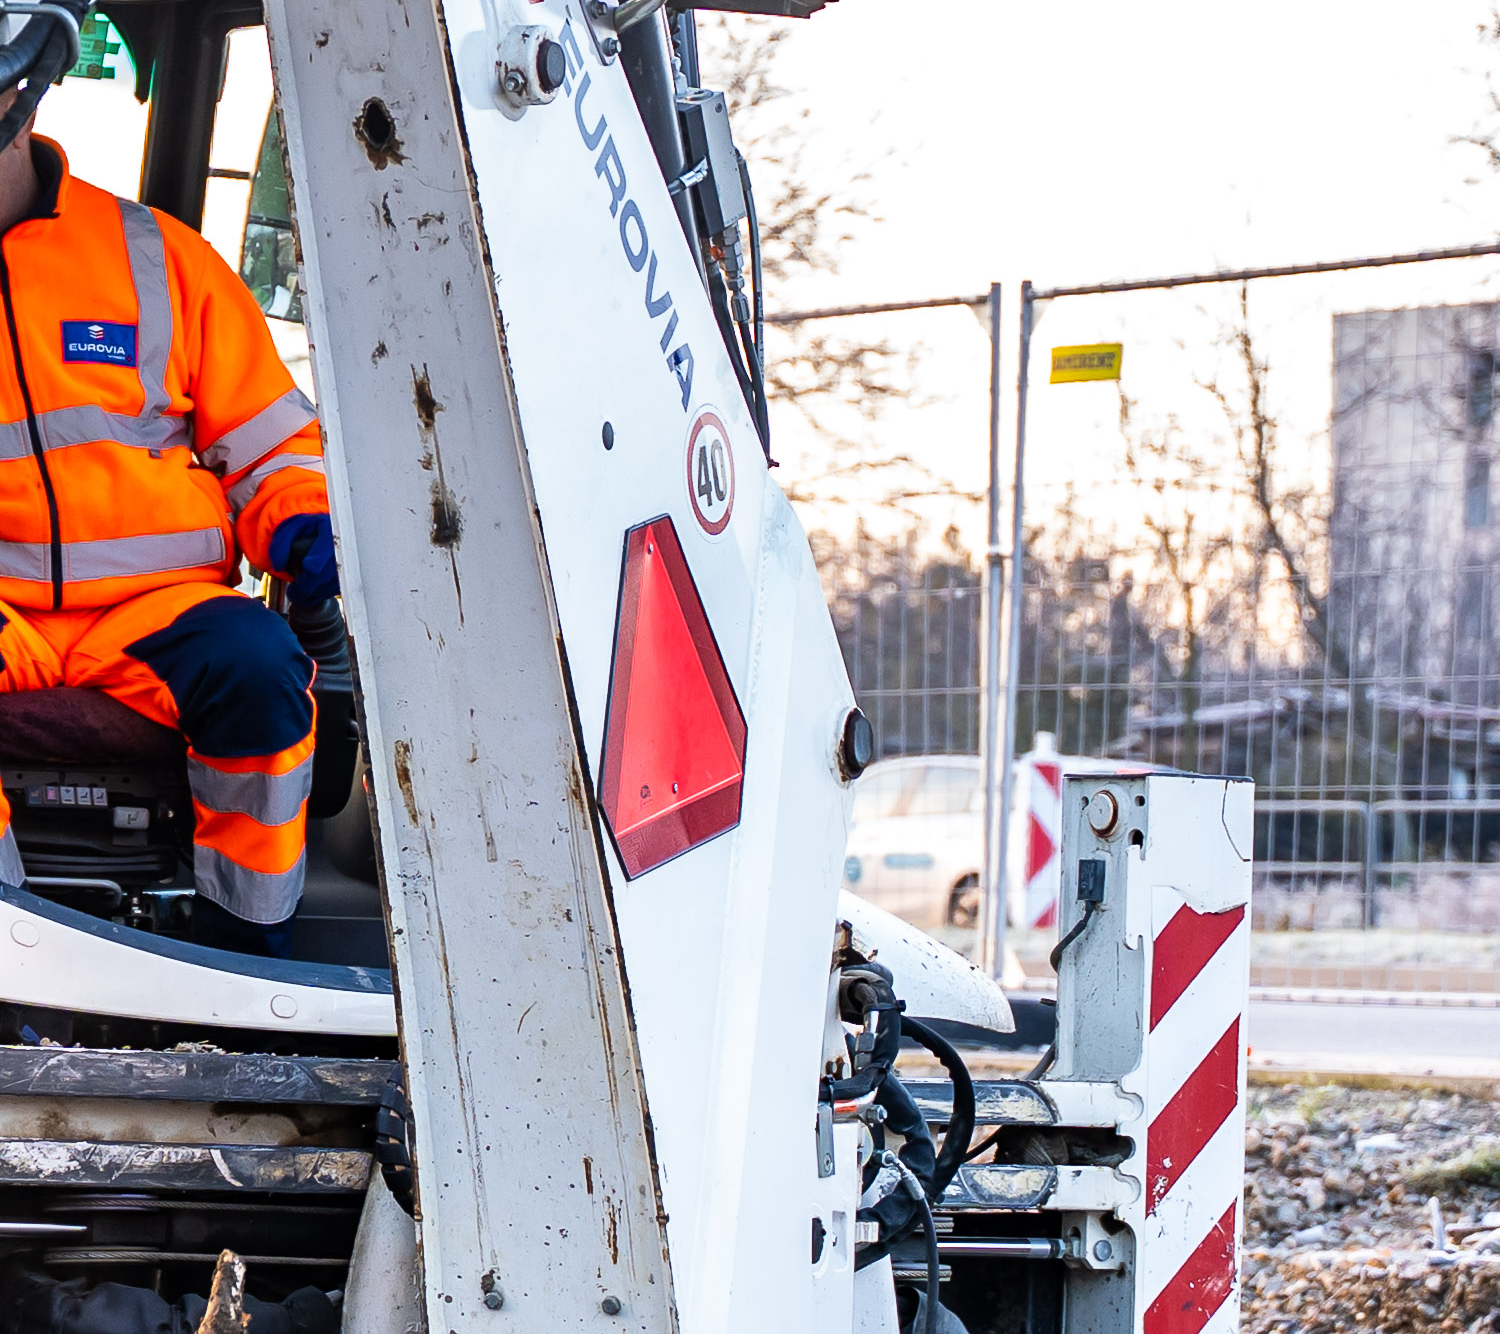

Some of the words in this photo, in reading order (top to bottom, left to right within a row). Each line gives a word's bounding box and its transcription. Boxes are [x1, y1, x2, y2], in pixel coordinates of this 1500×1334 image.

[559, 17, 695, 413] EUROVIA
[69, 343, 126, 355] EUROVIA
[698, 439, 727, 507] 40
